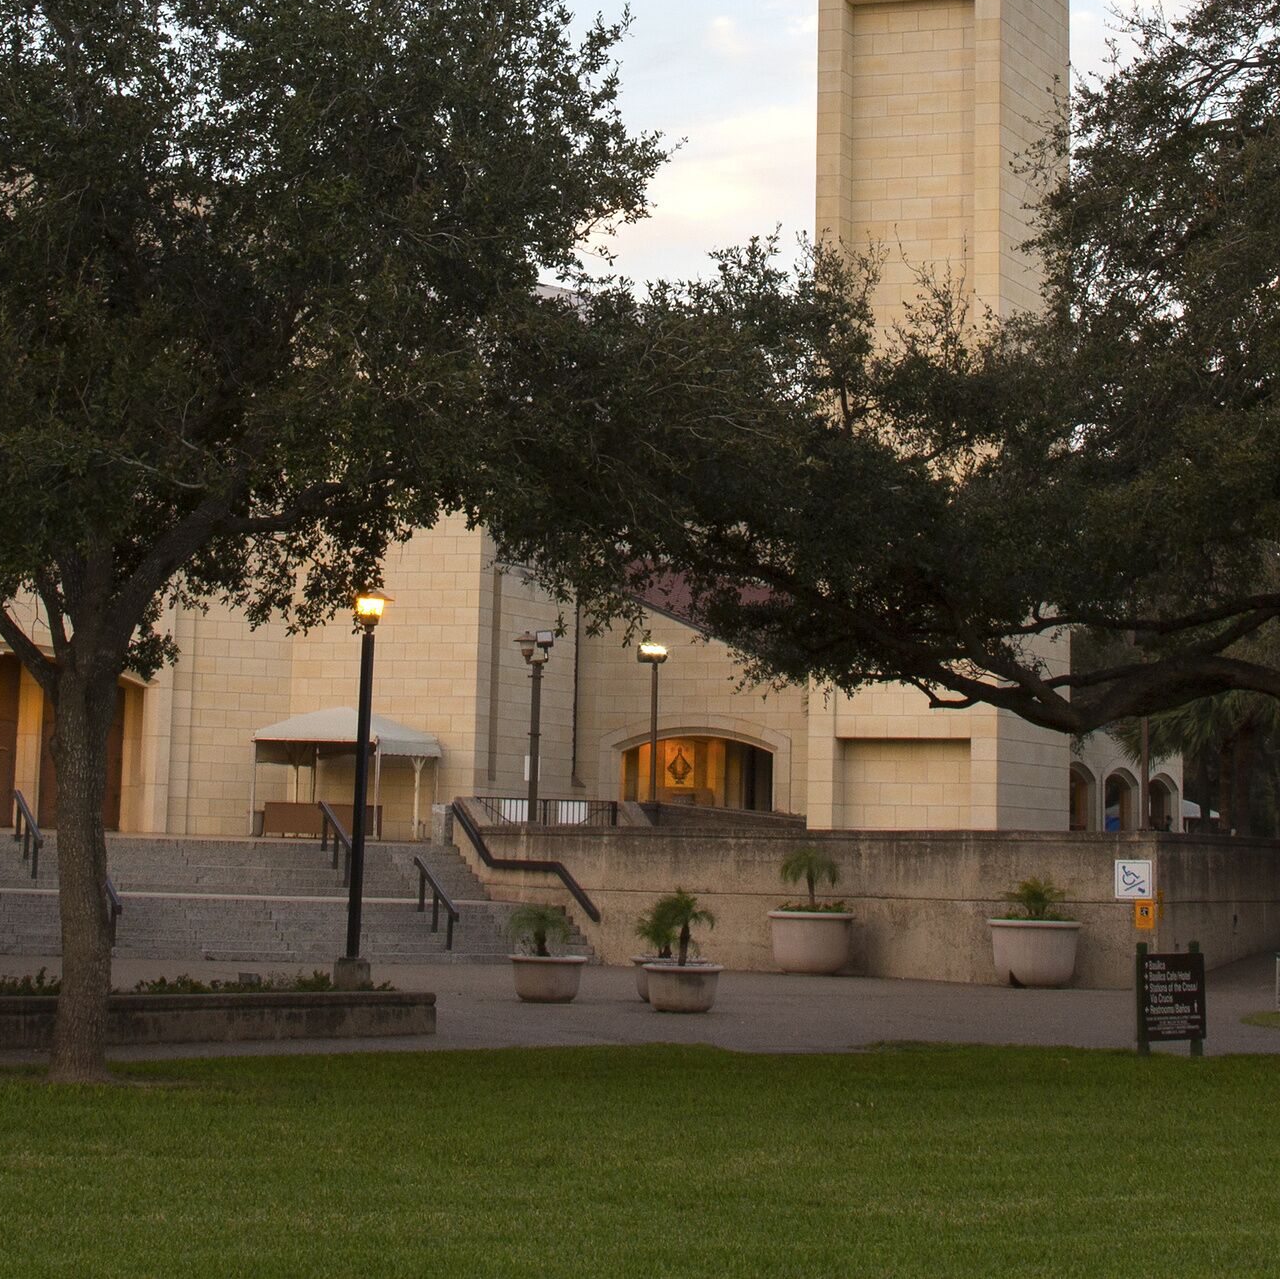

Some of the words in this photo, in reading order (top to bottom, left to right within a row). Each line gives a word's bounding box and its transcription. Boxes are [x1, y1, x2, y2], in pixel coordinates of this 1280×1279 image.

[1148, 960, 1166, 970] Basilica
[1148, 971, 1166, 981] Basilica
[1149, 982, 1167, 992] Stations
[1168, 982, 1174, 992] of
[1174, 982, 1182, 992] the
